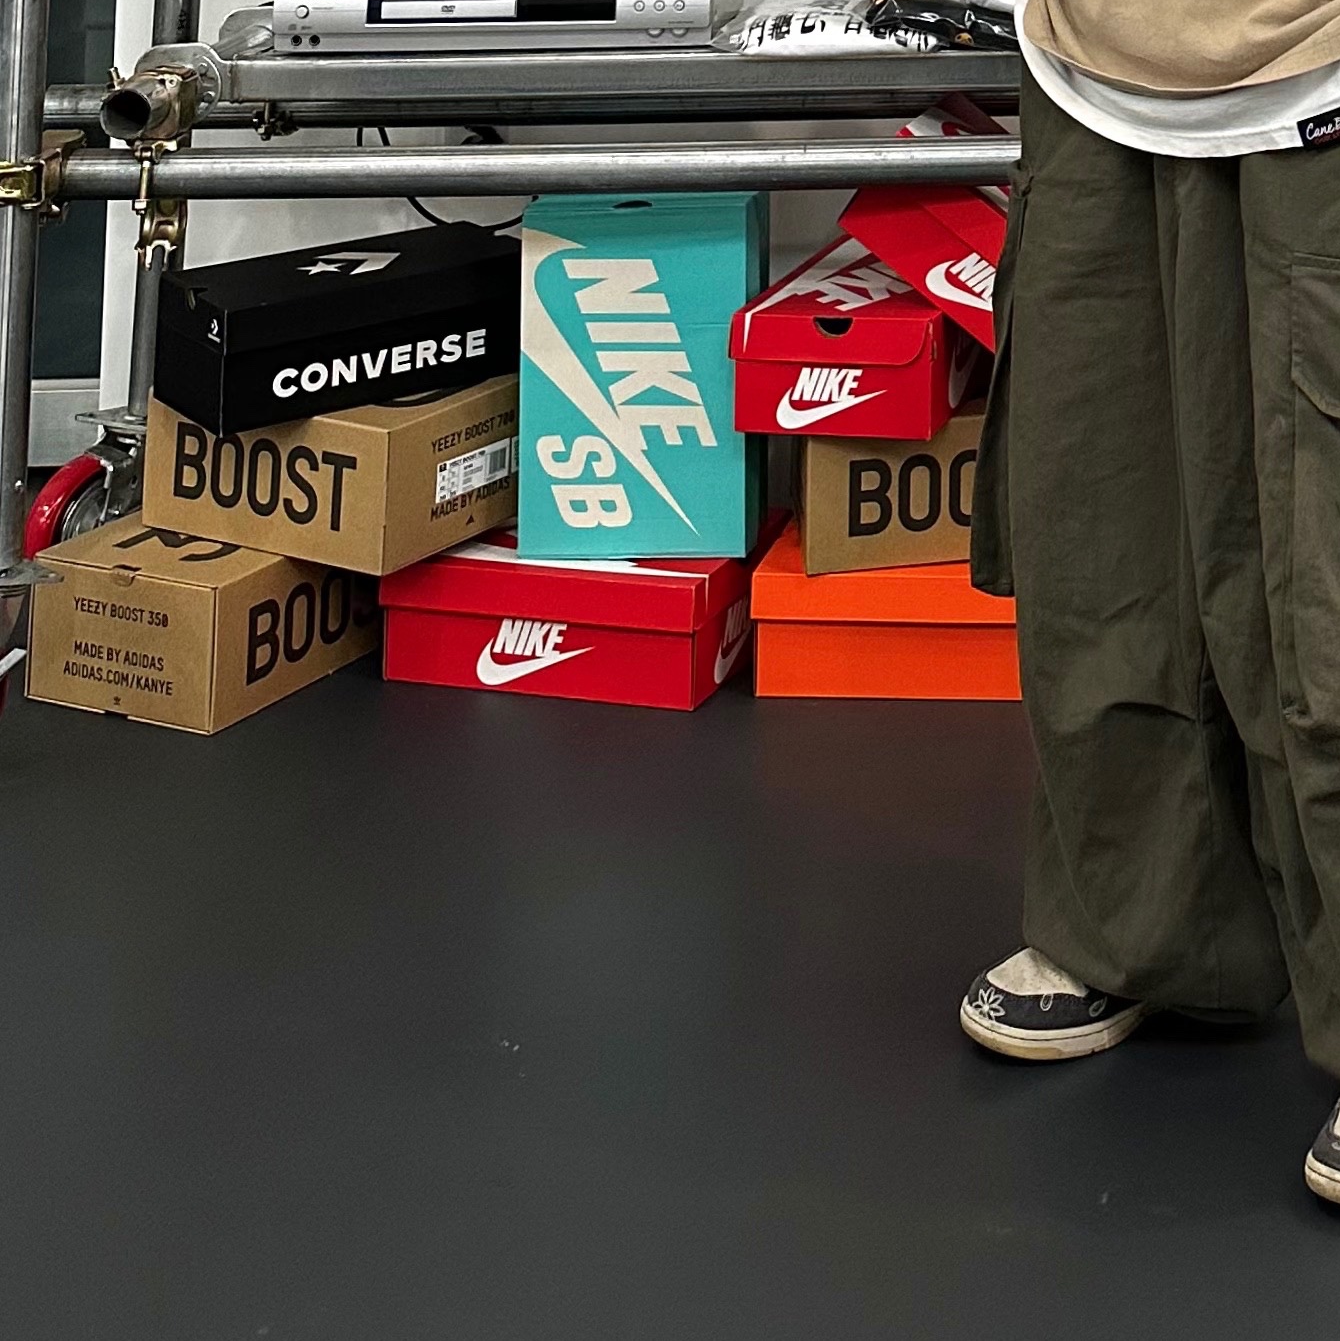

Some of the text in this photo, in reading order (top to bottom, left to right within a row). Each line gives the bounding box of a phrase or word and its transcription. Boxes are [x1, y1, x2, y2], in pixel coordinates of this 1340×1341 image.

[272, 328, 487, 398] CONVERSE
[562, 258, 718, 448] NIKE
[792, 367, 863, 403] NIKE
[431, 429, 463, 455] YEEZY
[464, 416, 495, 442] BOOST
[173, 421, 358, 533] BOOST
[536, 434, 633, 529] SB
[430, 476, 510, 521] MADE BY ADIDAS
[74, 596, 169, 628] YEEZY BOOST 350
[74, 640, 164, 672] MADE BY ADIDAS
[494, 618, 567, 657] NIKE
[63, 660, 174, 696] ADIDAS.COM/KANYE
